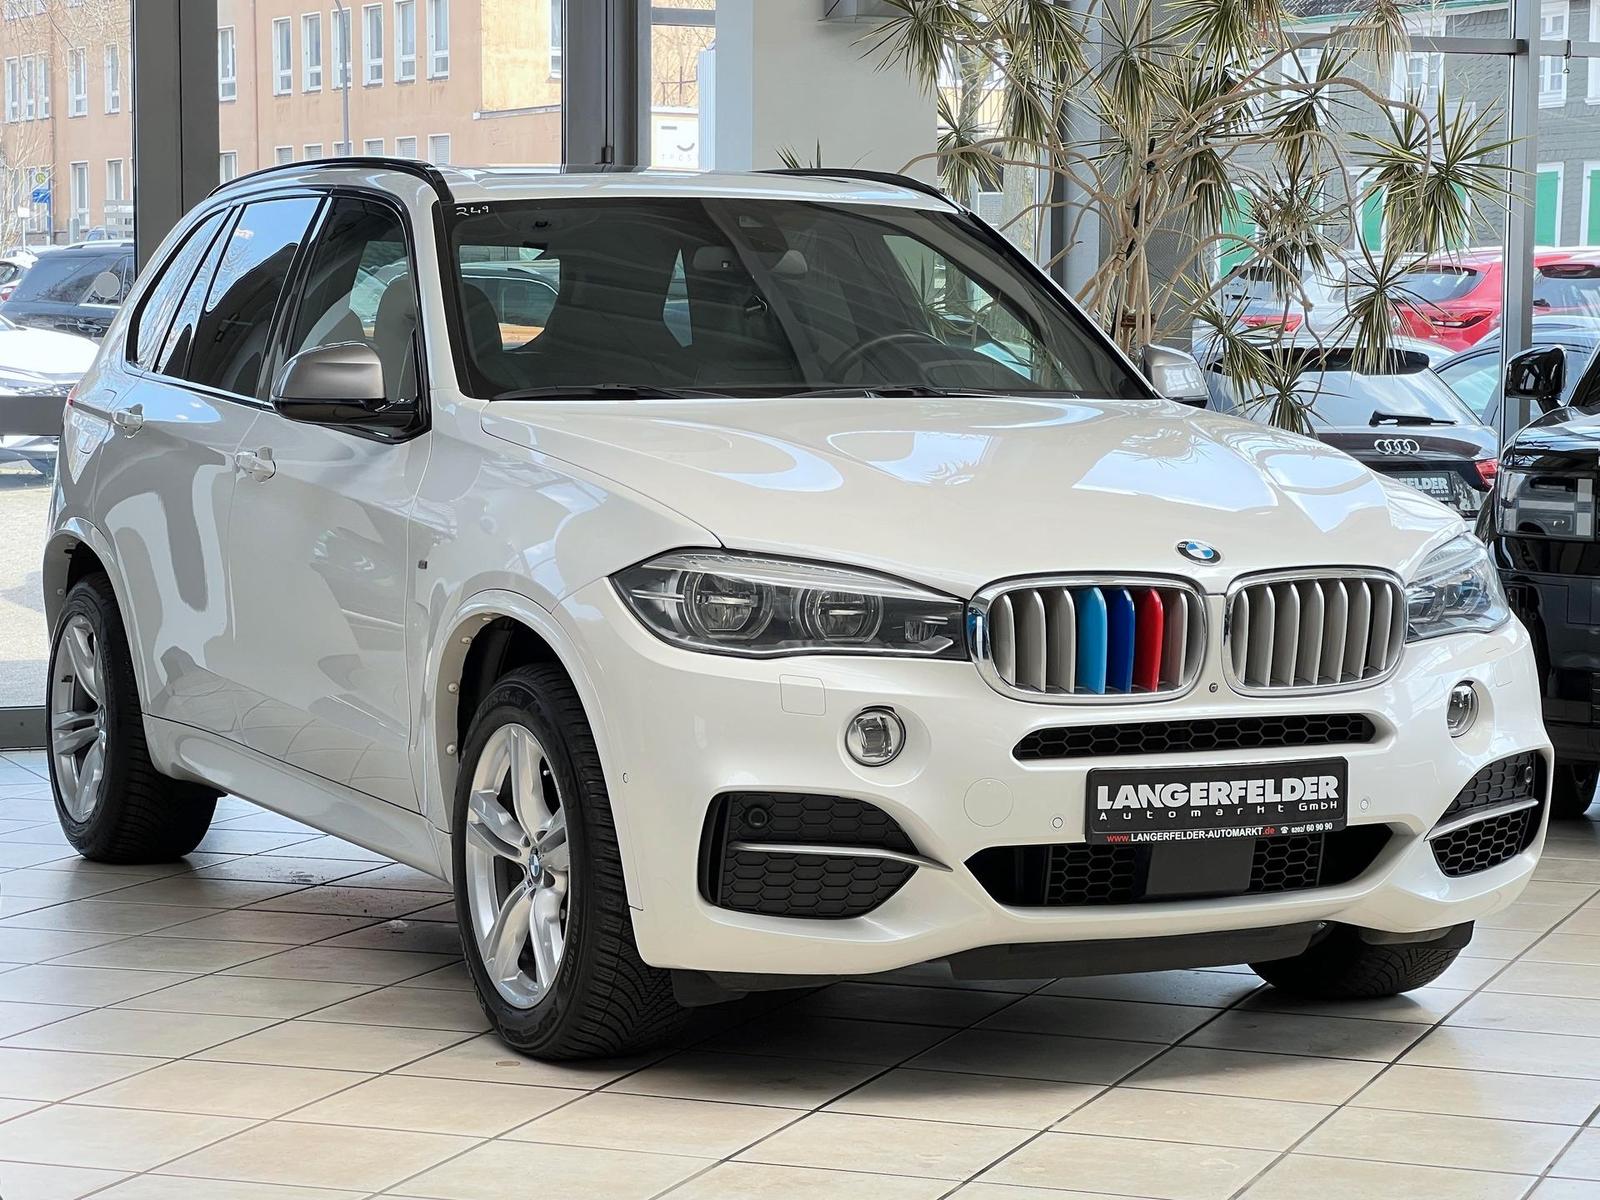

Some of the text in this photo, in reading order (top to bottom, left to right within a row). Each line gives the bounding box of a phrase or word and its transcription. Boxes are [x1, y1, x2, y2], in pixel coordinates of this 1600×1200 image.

[1097, 775, 1339, 810] LANGERFELDER
[1298, 800, 1338, 812] GmbH
[1106, 826, 1276, 843] www.LANGERFELDER-AUTOMARKT.de
[1306, 823, 1315, 832] 60
[1315, 823, 1324, 831] 90
[1324, 822, 1333, 830] 90
